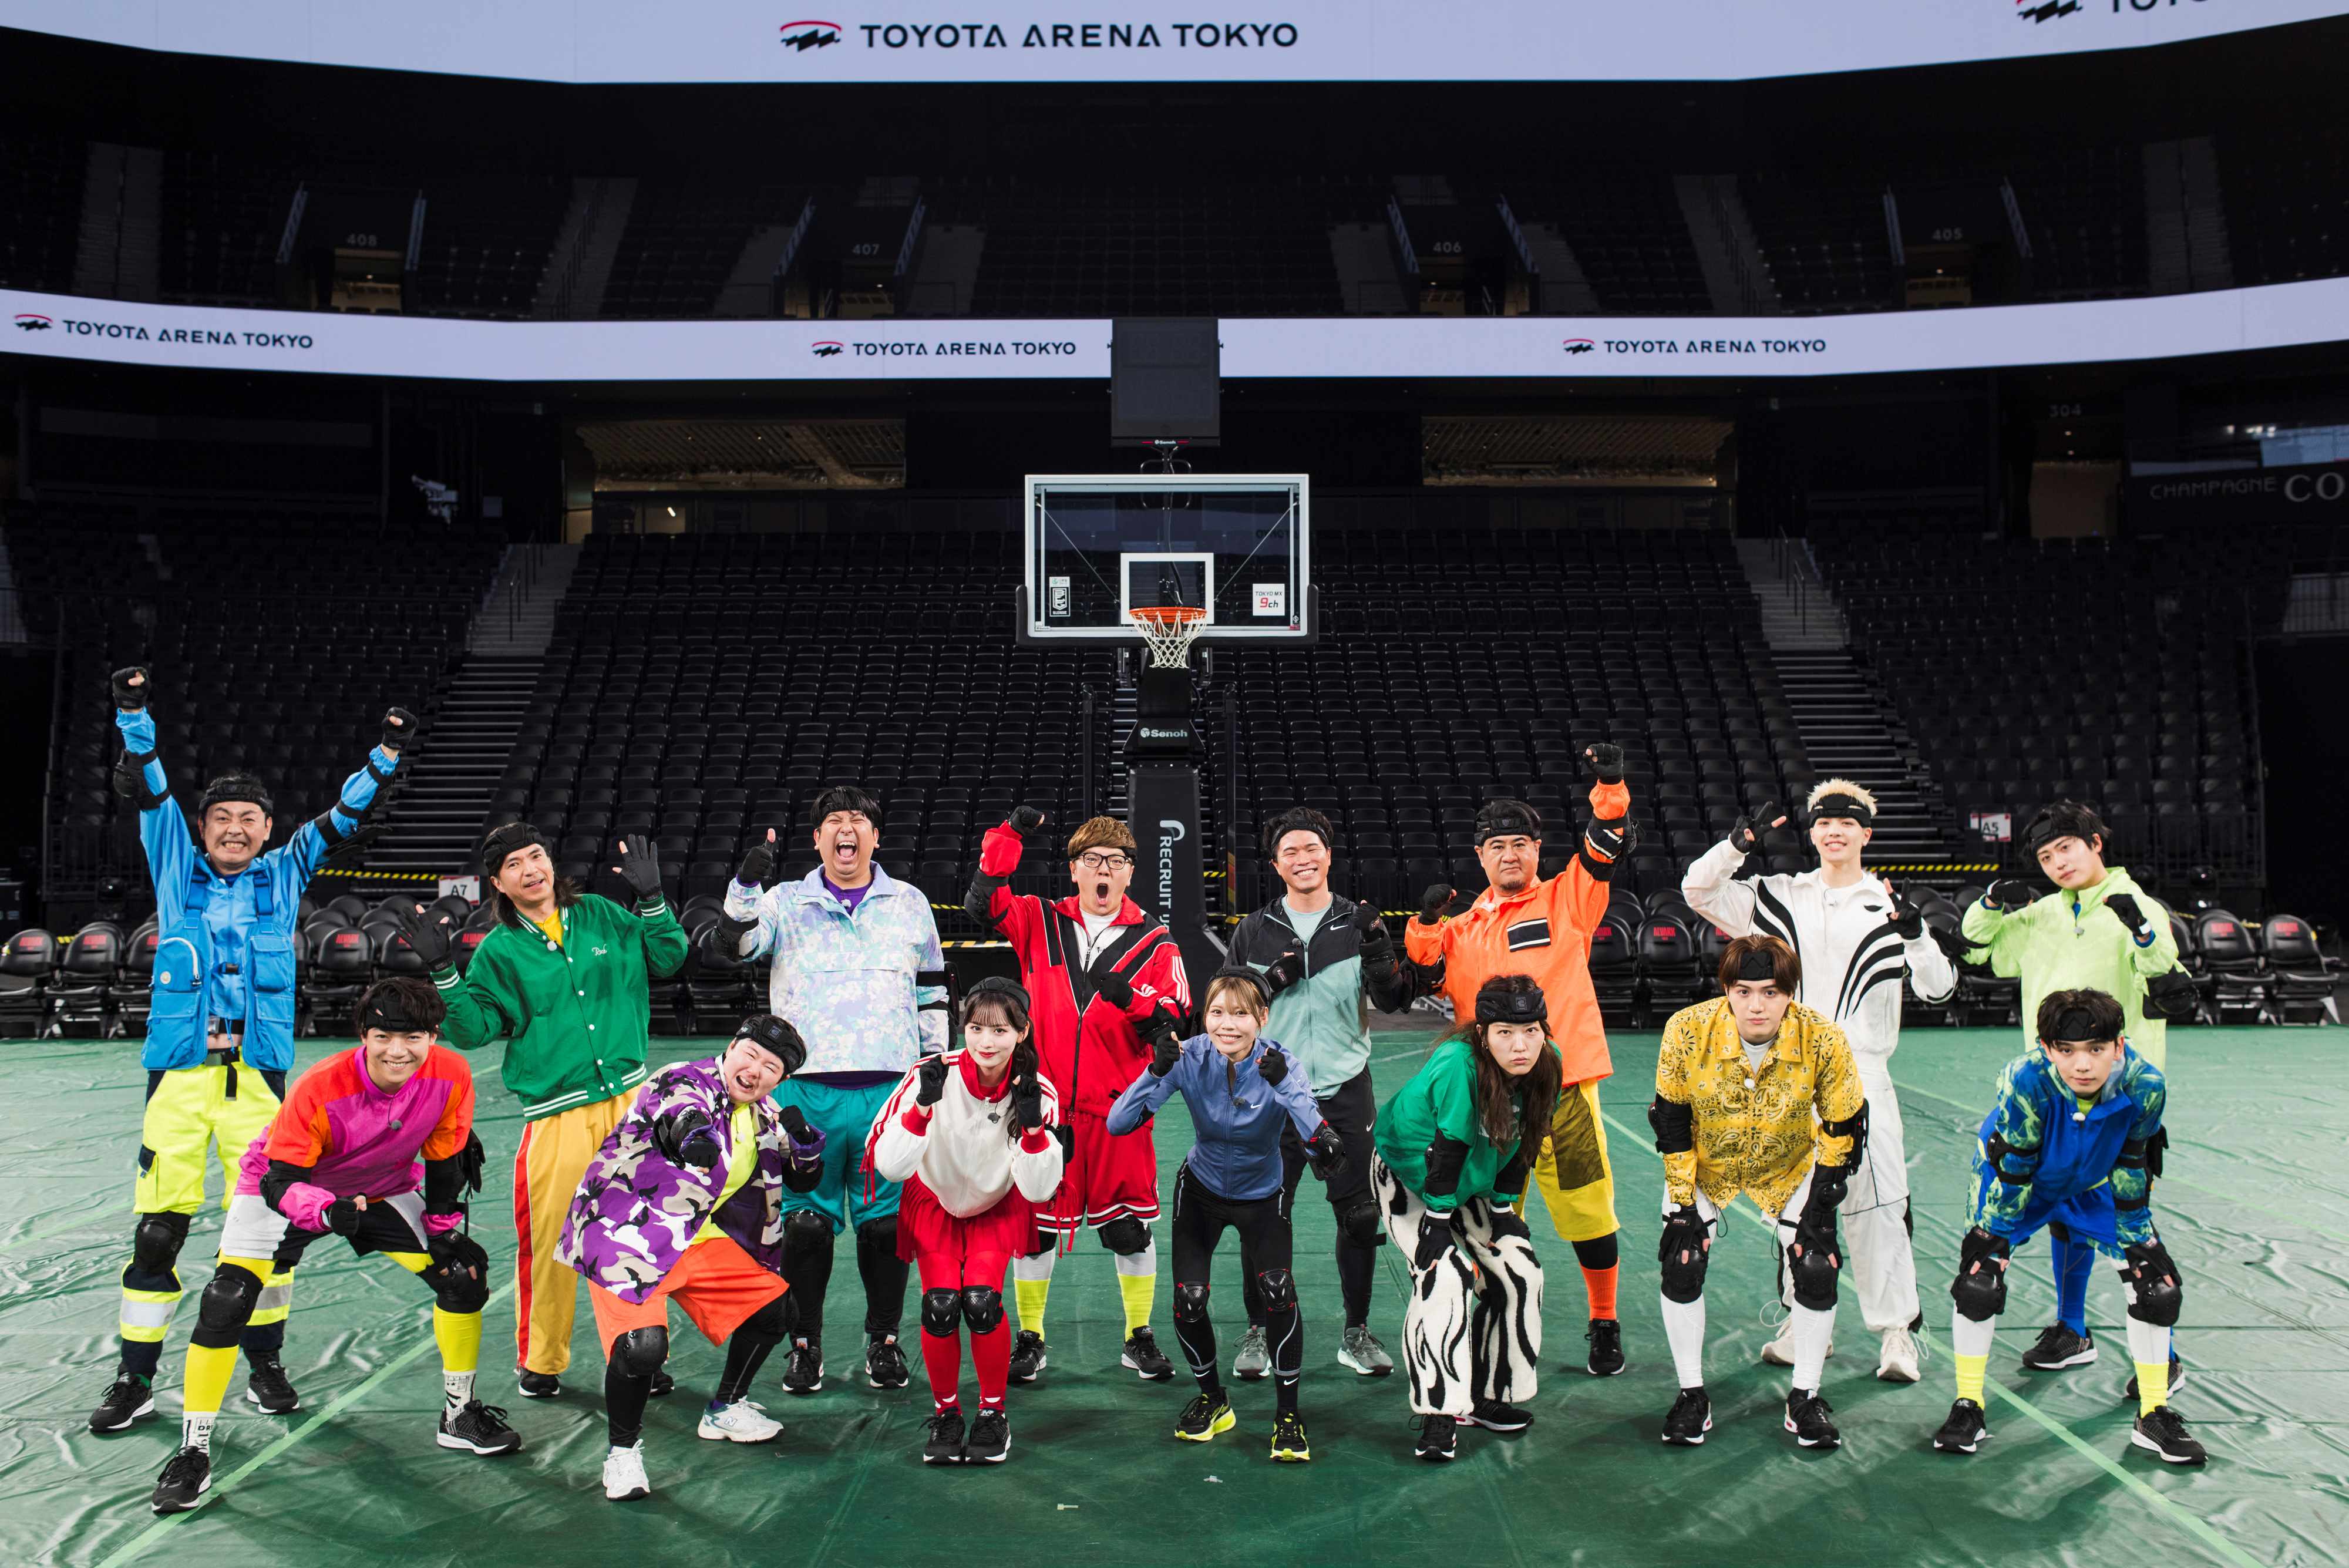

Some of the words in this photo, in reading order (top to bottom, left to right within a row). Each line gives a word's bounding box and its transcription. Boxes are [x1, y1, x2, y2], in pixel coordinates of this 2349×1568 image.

[860, 24, 1007, 48] TOYOTA
[1022, 24, 1160, 48] ARENA
[1172, 23, 1298, 48] TOKYO
[1931, 227, 1963, 241] 405
[852, 244, 880, 255] 407
[1433, 241, 1462, 253] 406
[63, 320, 149, 341] TOYOTA
[158, 329, 237, 345] ARENA
[243, 333, 313, 349] TOKYO
[853, 342, 928, 356] TOYOTA
[935, 343, 1005, 355] ARENA
[1012, 342, 1076, 355] TOKYO
[1603, 341, 1678, 354] TOYOTA
[1687, 340, 1756, 353] ARENA
[1762, 339, 1826, 354] TOKYO
[2149, 475, 2279, 500] CHAMPAGNE
[2283, 472, 2346, 503] CO
[1150, 729, 1188, 738] Senoh
[1983, 822, 1999, 834] A5
[1159, 836, 1172, 909] RECRUIT
[450, 884, 467, 897] A7
